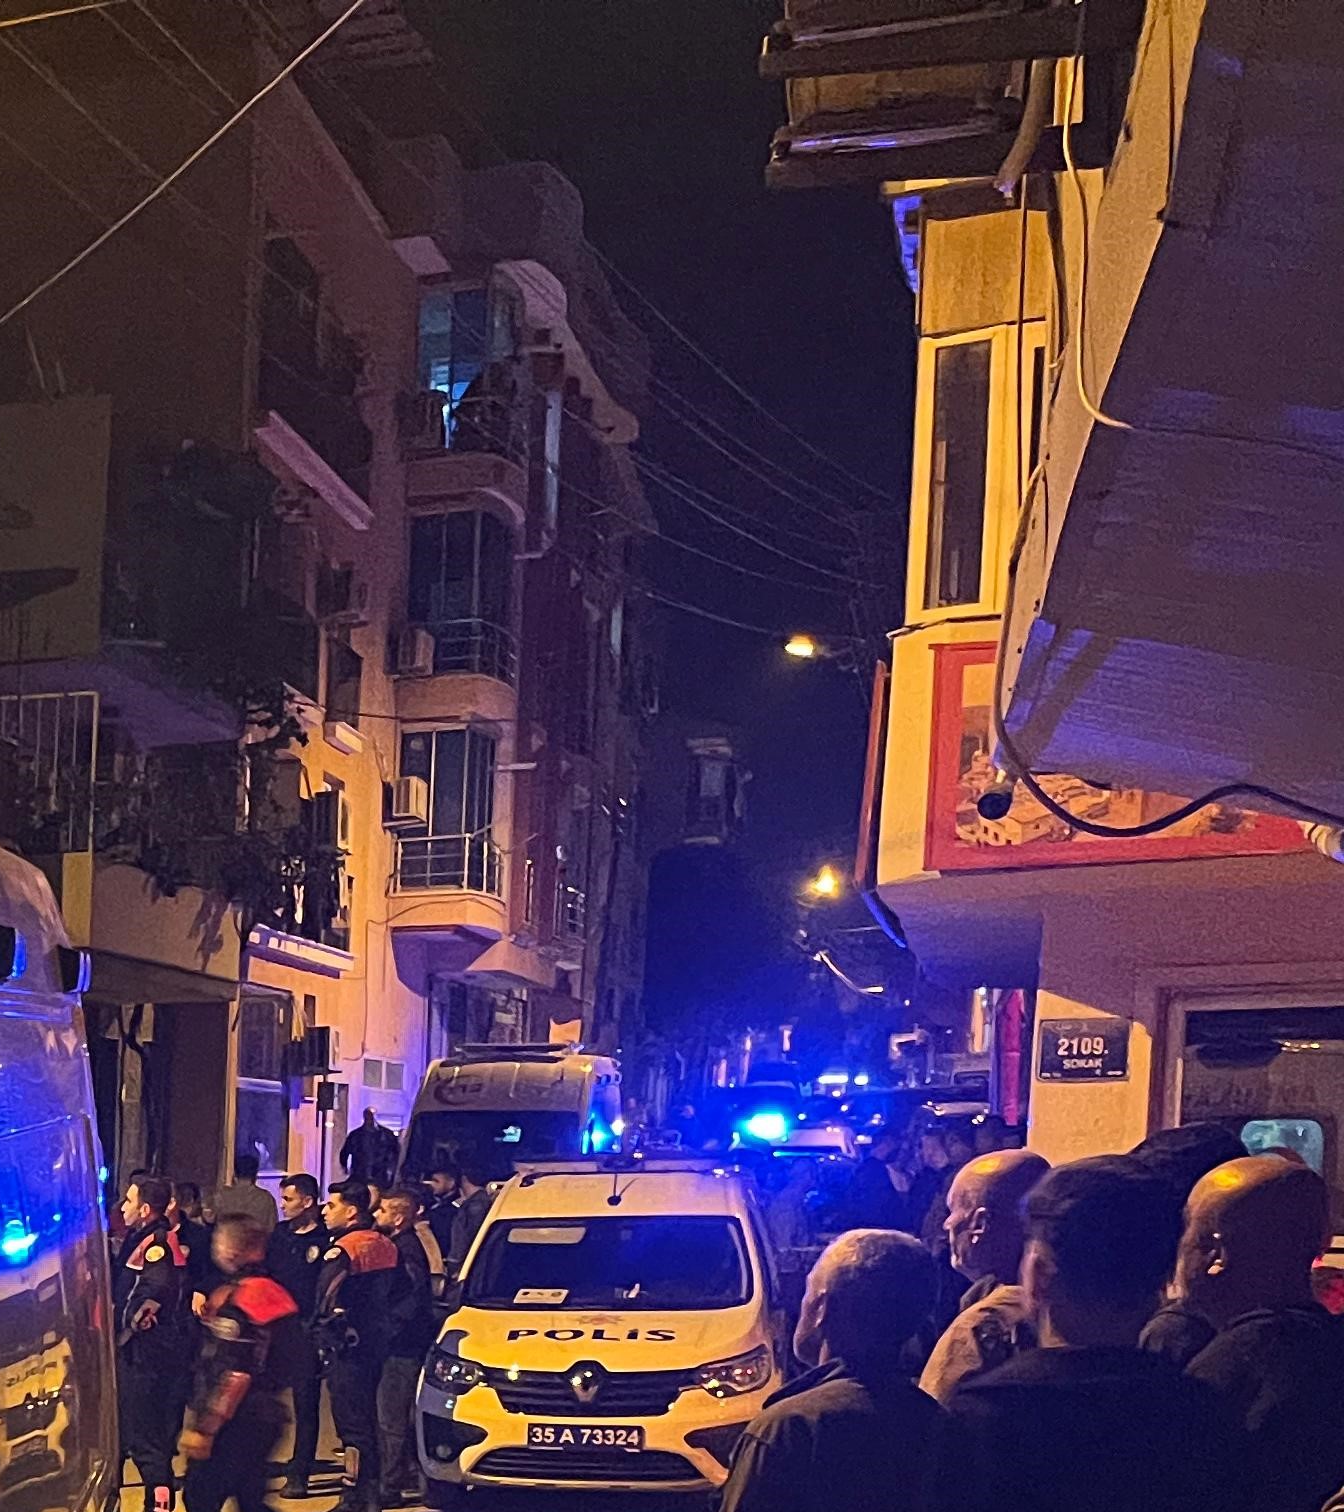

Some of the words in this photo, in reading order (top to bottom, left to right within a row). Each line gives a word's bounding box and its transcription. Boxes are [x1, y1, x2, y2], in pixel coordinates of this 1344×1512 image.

[1057, 1037, 1109, 1056] 2109.
[531, 1427, 555, 1443] 35
[559, 1429, 574, 1444] A
[580, 1429, 639, 1445] 73324
